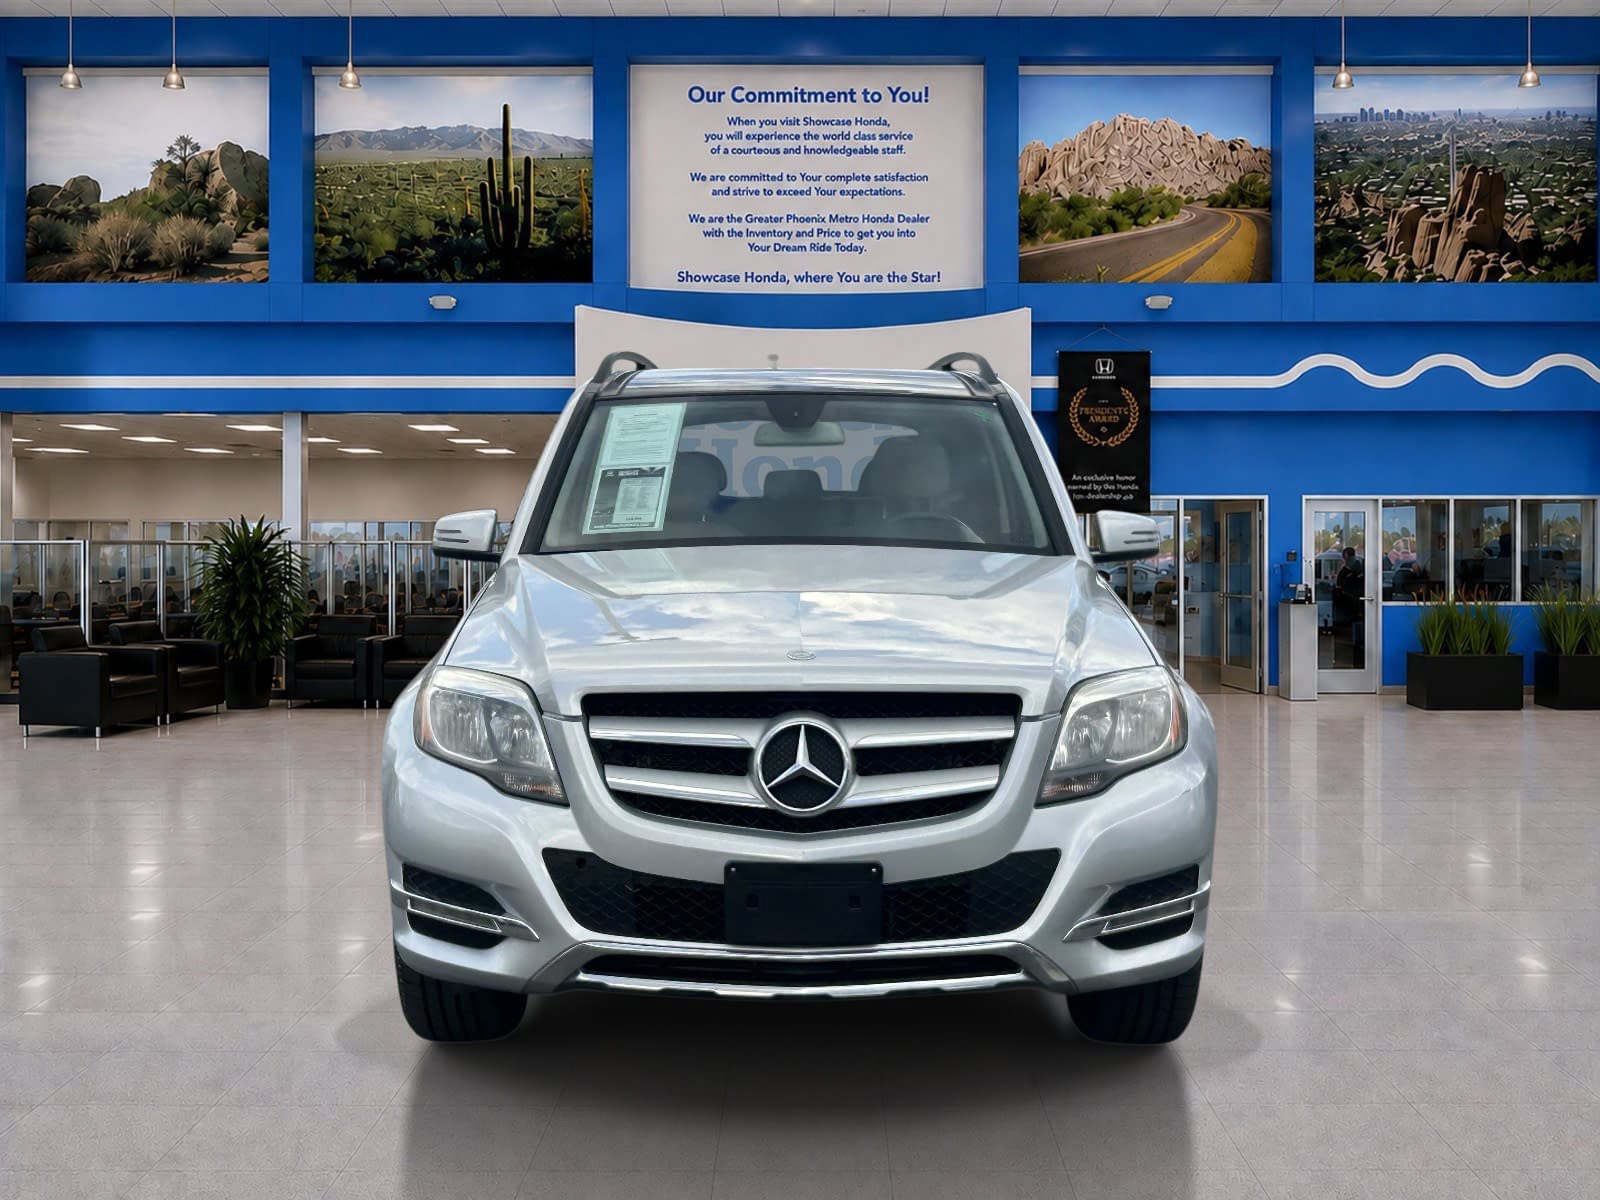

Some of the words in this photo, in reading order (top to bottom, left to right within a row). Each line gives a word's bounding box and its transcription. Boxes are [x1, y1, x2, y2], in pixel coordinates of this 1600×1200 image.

[687, 85, 727, 104] Our
[730, 85, 857, 104] Commitment
[860, 87, 883, 104] to
[886, 85, 930, 104] You!
[726, 115, 757, 127] When
[758, 118, 778, 129] you
[779, 116, 801, 127] visit
[802, 115, 853, 127] Showcase
[854, 116, 891, 128] Honda,
[704, 132, 724, 144] you
[725, 130, 743, 141] will
[744, 130, 801, 144] experience
[802, 130, 820, 141] the
[821, 130, 851, 142] world
[852, 130, 877, 142] class
[878, 130, 914, 142] service
[709, 144, 722, 156] of
[722, 147, 730, 156] a
[730, 146, 782, 156] courteous
[782, 144, 802, 155] and
[881, 144, 907, 155] staff.
[689, 171, 708, 183] We
[709, 174, 727, 183] are
[728, 171, 784, 183] committed
[785, 173, 798, 183] to
[799, 172, 823, 183] Your
[824, 171, 872, 185] complete
[873, 171, 929, 183] satisfaction
[711, 185, 731, 197] and
[731, 186, 761, 197] strive
[762, 187, 774, 197] to
[775, 186, 812, 197] exceed
[813, 186, 838, 197] Your
[838, 186, 906, 200] expectations.
[687, 213, 707, 224] We
[707, 215, 725, 224] are
[725, 213, 744, 224] the
[744, 213, 785, 224] Greater
[785, 213, 827, 224] Phoenix
[828, 213, 860, 224] Metro
[861, 213, 896, 224] Honda
[897, 213, 931, 224] Dealer
[702, 227, 725, 238] with
[726, 227, 744, 239] the
[745, 227, 794, 241] Inventory
[794, 227, 815, 239] and
[816, 227, 842, 239] Price
[843, 229, 855, 238] to
[856, 228, 875, 241] get
[875, 229, 895, 241] you
[896, 227, 917, 239] into
[747, 242, 772, 253] Your
[773, 242, 808, 253] Dream
[809, 242, 833, 253] Ride
[834, 242, 867, 255] Today.
[676, 270, 741, 284] Showcase
[744, 270, 791, 286] Honda,
[793, 270, 834, 284] where
[836, 271, 861, 284] You
[863, 274, 884, 284] are
[886, 270, 908, 284] the
[910, 270, 941, 284] Star!
